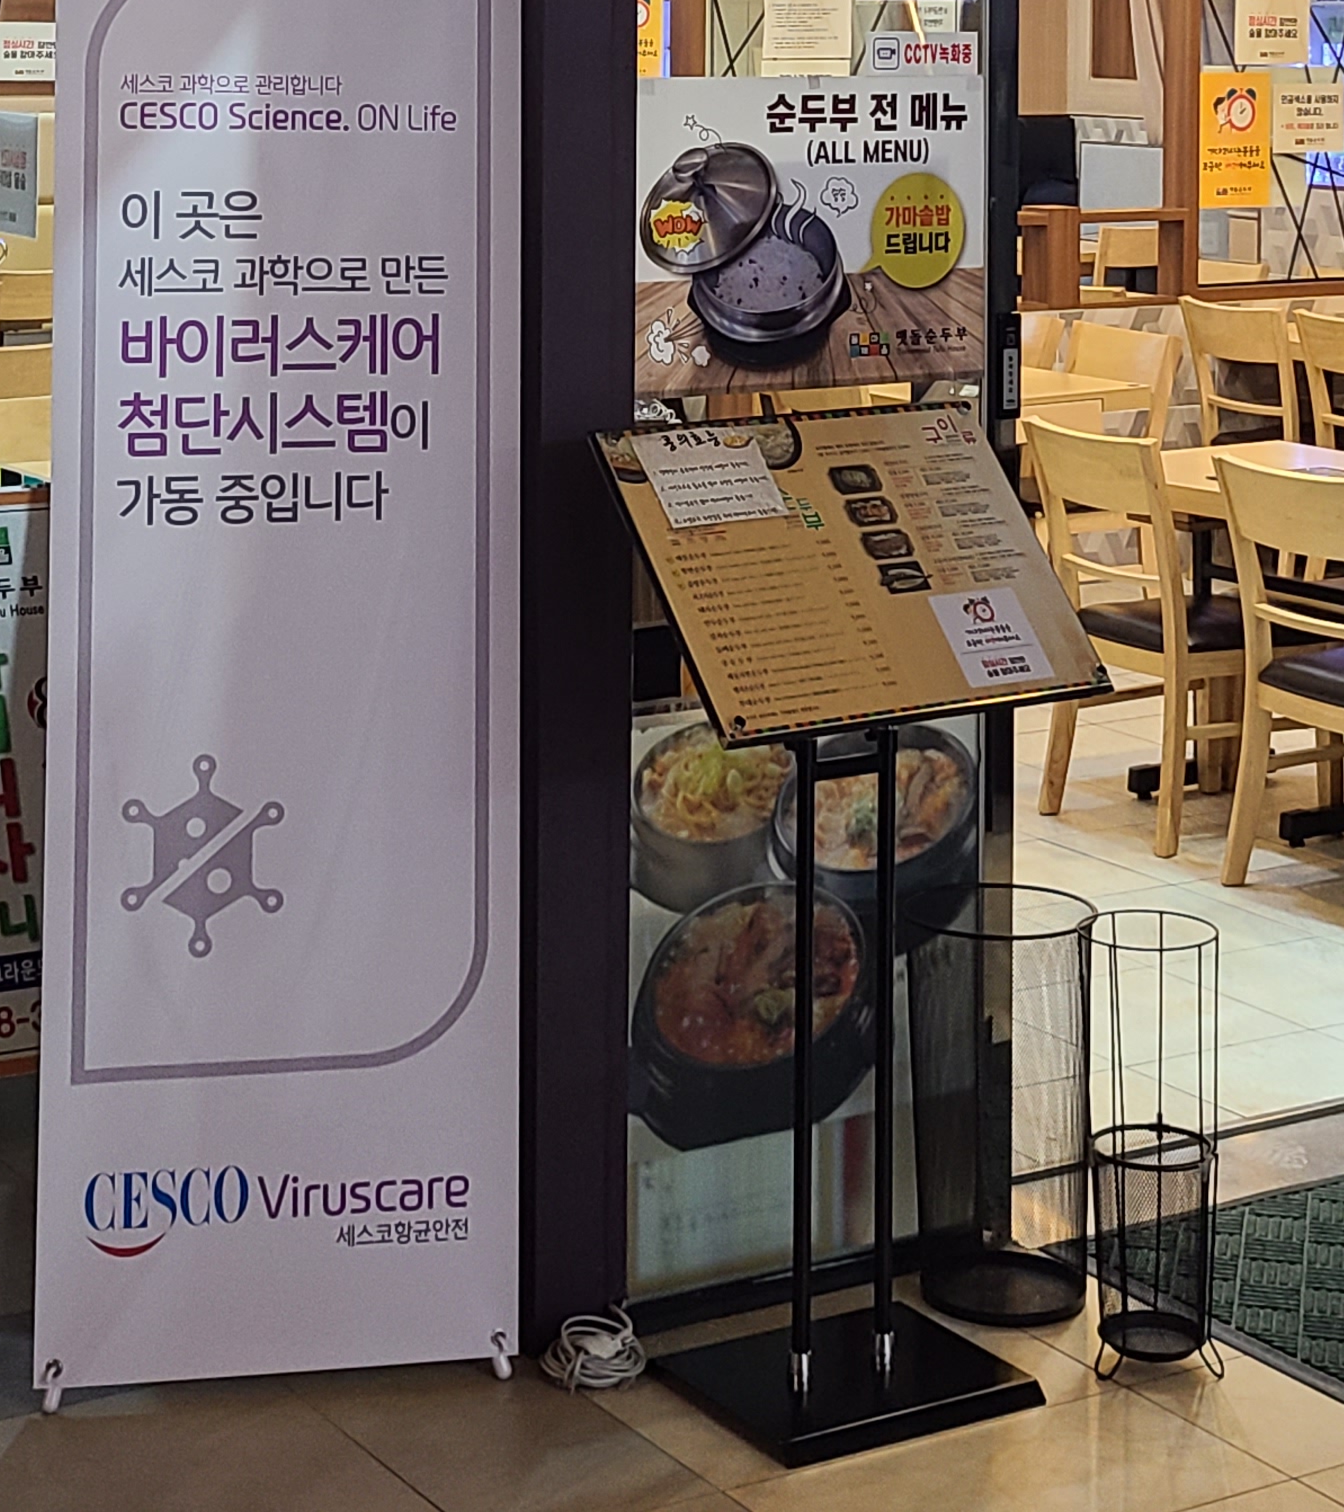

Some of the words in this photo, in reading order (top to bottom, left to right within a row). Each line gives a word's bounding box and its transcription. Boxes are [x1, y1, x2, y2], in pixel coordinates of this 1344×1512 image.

[903, 42, 973, 65] CCTV녹화중
[119, 74, 174, 95] 세스코
[178, 74, 250, 95] 과학으로
[255, 75, 343, 97] 관리합니다
[119, 101, 219, 131] CESCO
[228, 101, 351, 132] Science.
[357, 103, 400, 132] ON
[407, 103, 458, 132] Life
[765, 92, 858, 135] 순두부
[869, 92, 899, 133] 전
[908, 91, 969, 132] 메뉴
[806, 138, 857, 168] (ALL
[862, 136, 931, 165] MENU)
[121, 190, 161, 240] 이
[175, 189, 264, 240] 곳은
[654, 210, 705, 240] WOW
[884, 204, 953, 228] 가마솥밥
[884, 230, 952, 255] 드립니다
[118, 256, 224, 297] 세스코
[233, 254, 372, 297] 과학으로
[380, 255, 450, 296] 만든
[120, 312, 441, 380] 바이러스케어
[117, 390, 430, 459] 첨단시스템이
[116, 474, 204, 526] 가동
[215, 471, 391, 525] 중입니다
[9, 603, 45, 618] House
[83, 1164, 250, 1233] CESCO
[257, 1173, 470, 1219] Viruscare
[336, 1216, 470, 1248] 세스코항균안전
